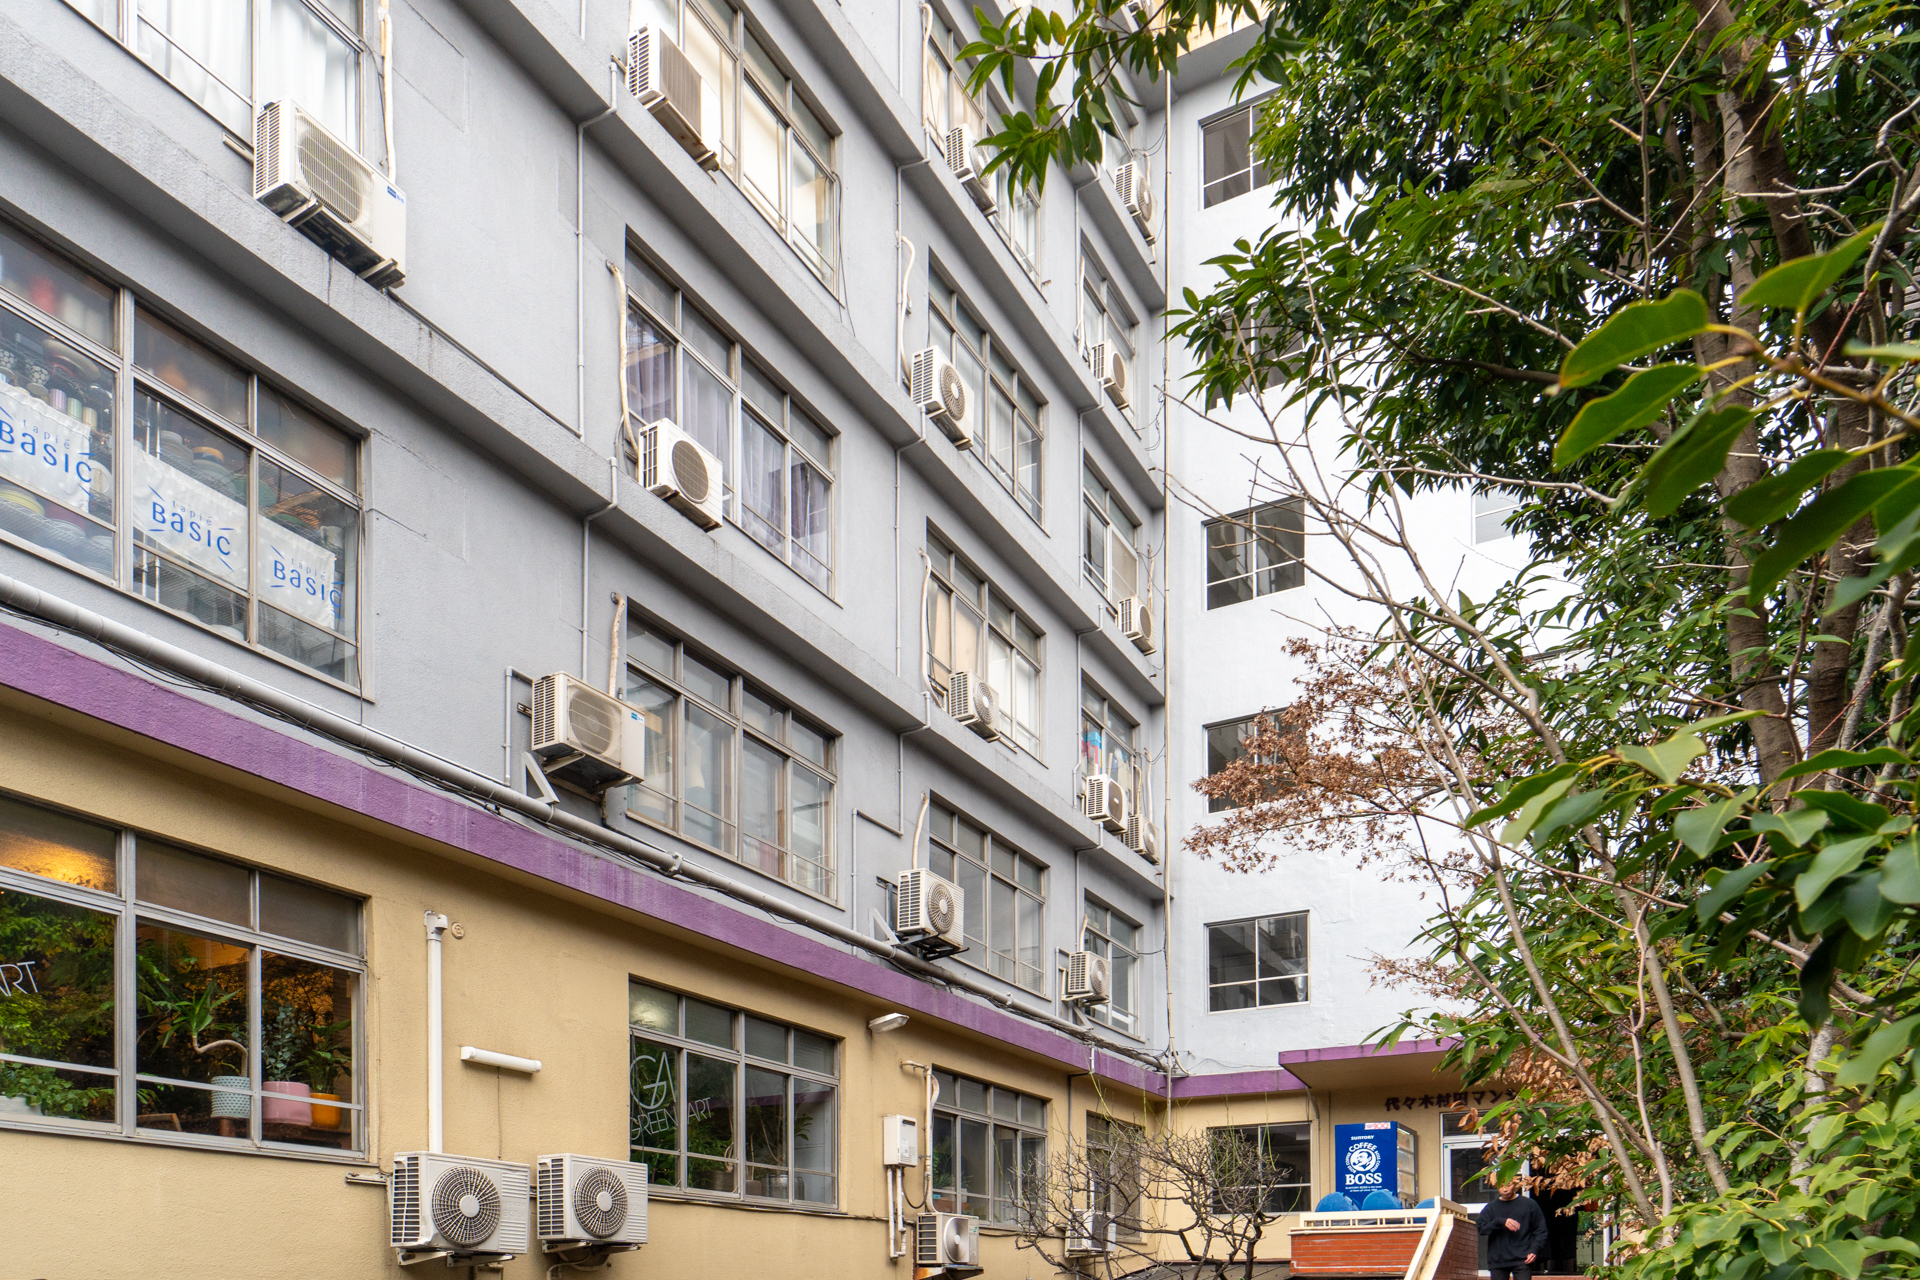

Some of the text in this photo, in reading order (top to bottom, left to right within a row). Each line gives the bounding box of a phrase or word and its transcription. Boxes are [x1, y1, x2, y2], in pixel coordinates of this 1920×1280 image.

[687, 1096, 712, 1125] ART
[1348, 1142, 1377, 1152] COFFEE
[1344, 1172, 1382, 1185] BOSS
